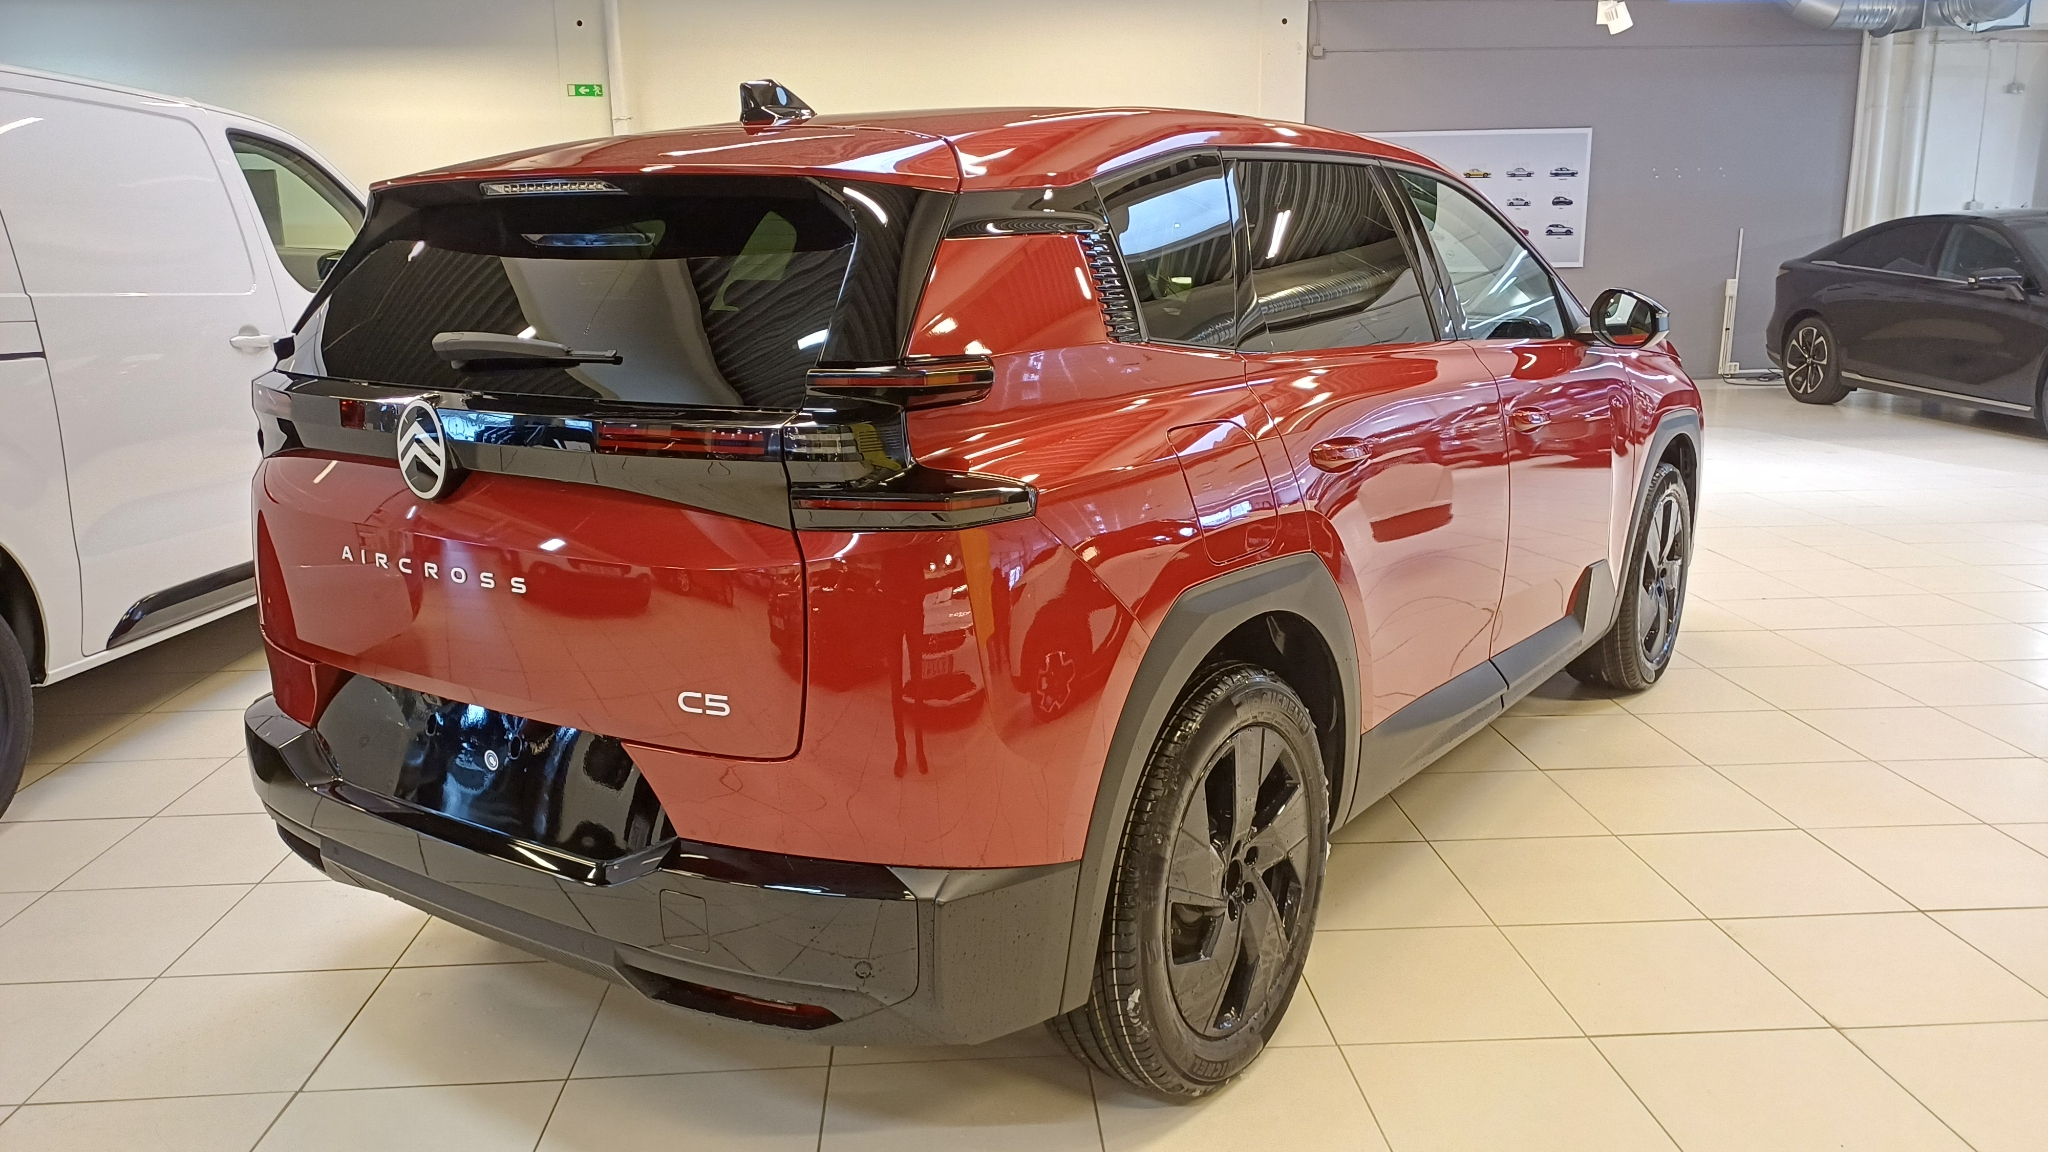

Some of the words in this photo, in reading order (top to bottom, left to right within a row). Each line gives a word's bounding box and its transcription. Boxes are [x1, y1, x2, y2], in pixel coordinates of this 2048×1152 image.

[341, 545, 527, 594] AIRCROSS
[677, 690, 731, 717] C5
[1261, 690, 1309, 732] MICHELIN
